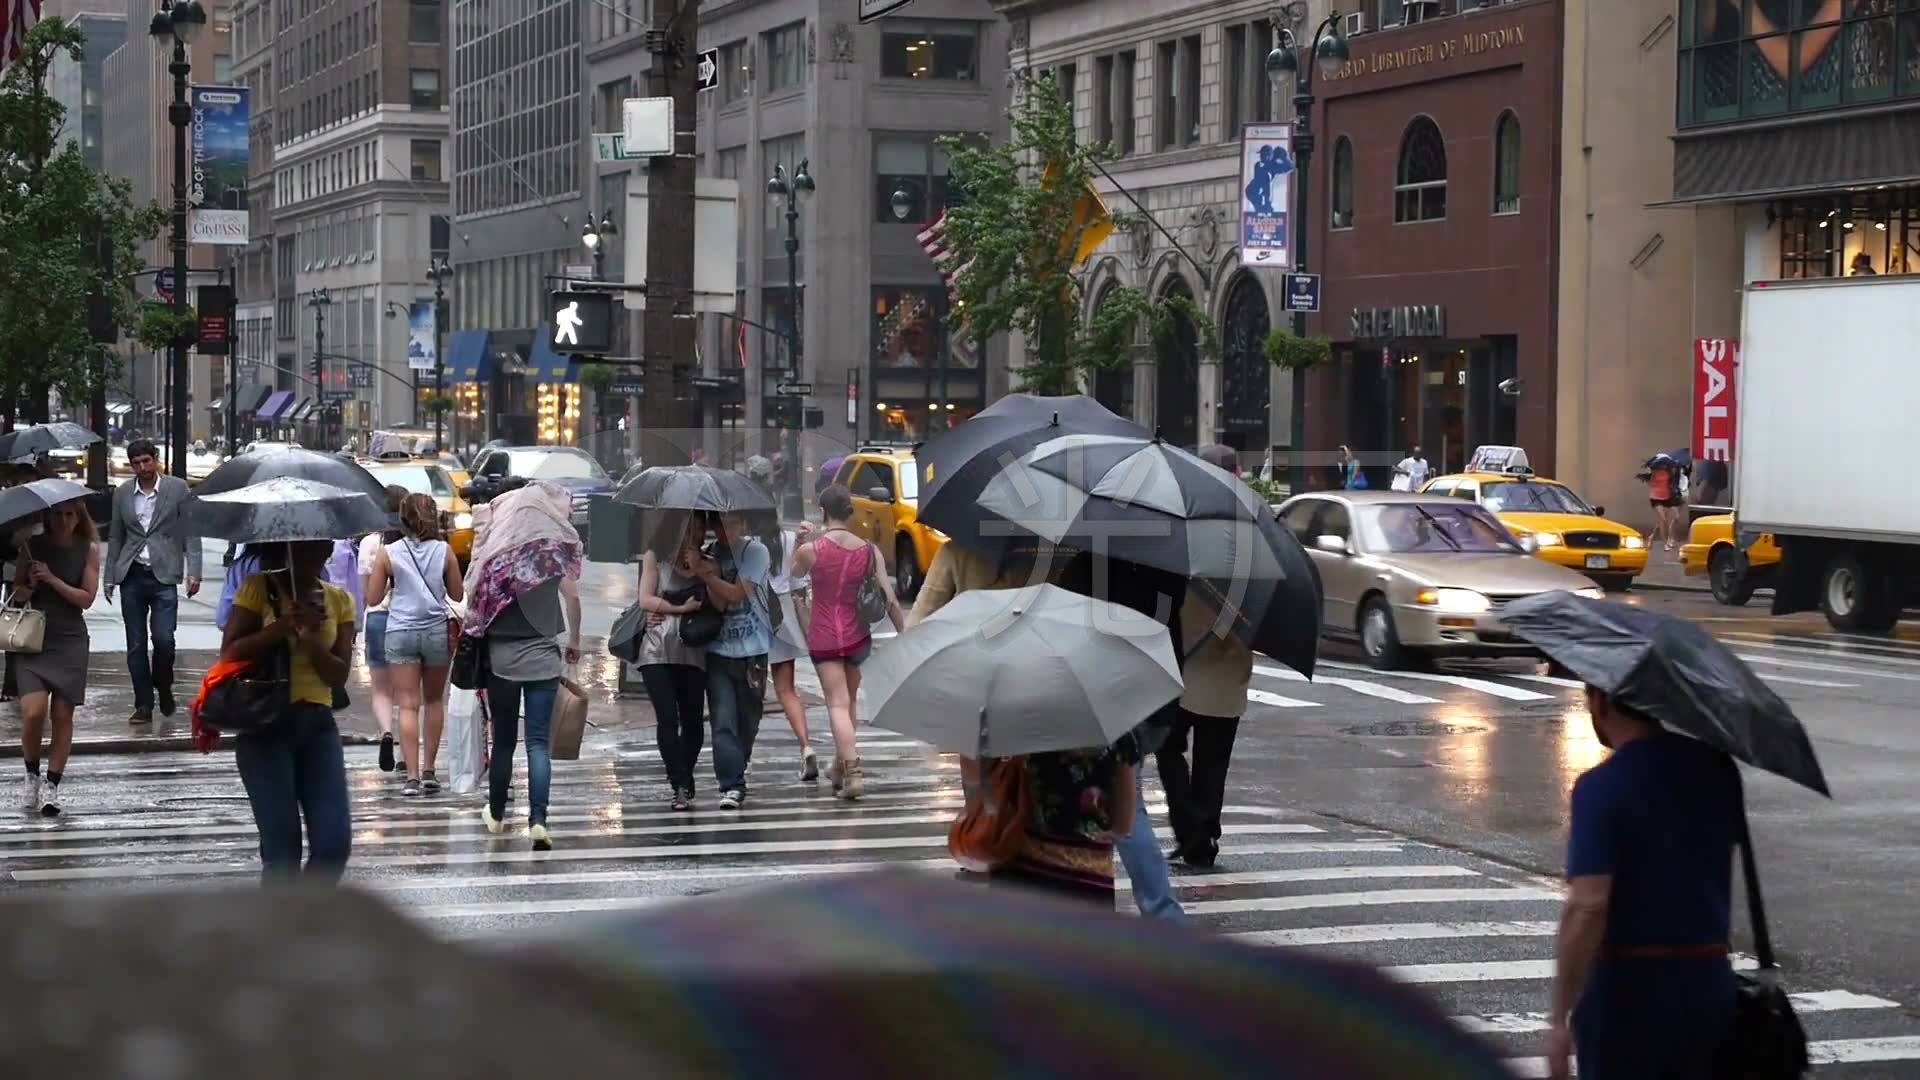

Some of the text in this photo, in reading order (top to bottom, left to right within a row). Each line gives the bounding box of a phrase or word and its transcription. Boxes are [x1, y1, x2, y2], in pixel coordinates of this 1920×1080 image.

[1371, 44, 1433, 73] LUBAVITCH
[1439, 39, 1456, 60] OF
[1463, 24, 1525, 55] MIDTOWN
[194, 108, 204, 140] ROCK
[194, 142, 204, 164] THE
[1701, 340, 1729, 462] SALE
